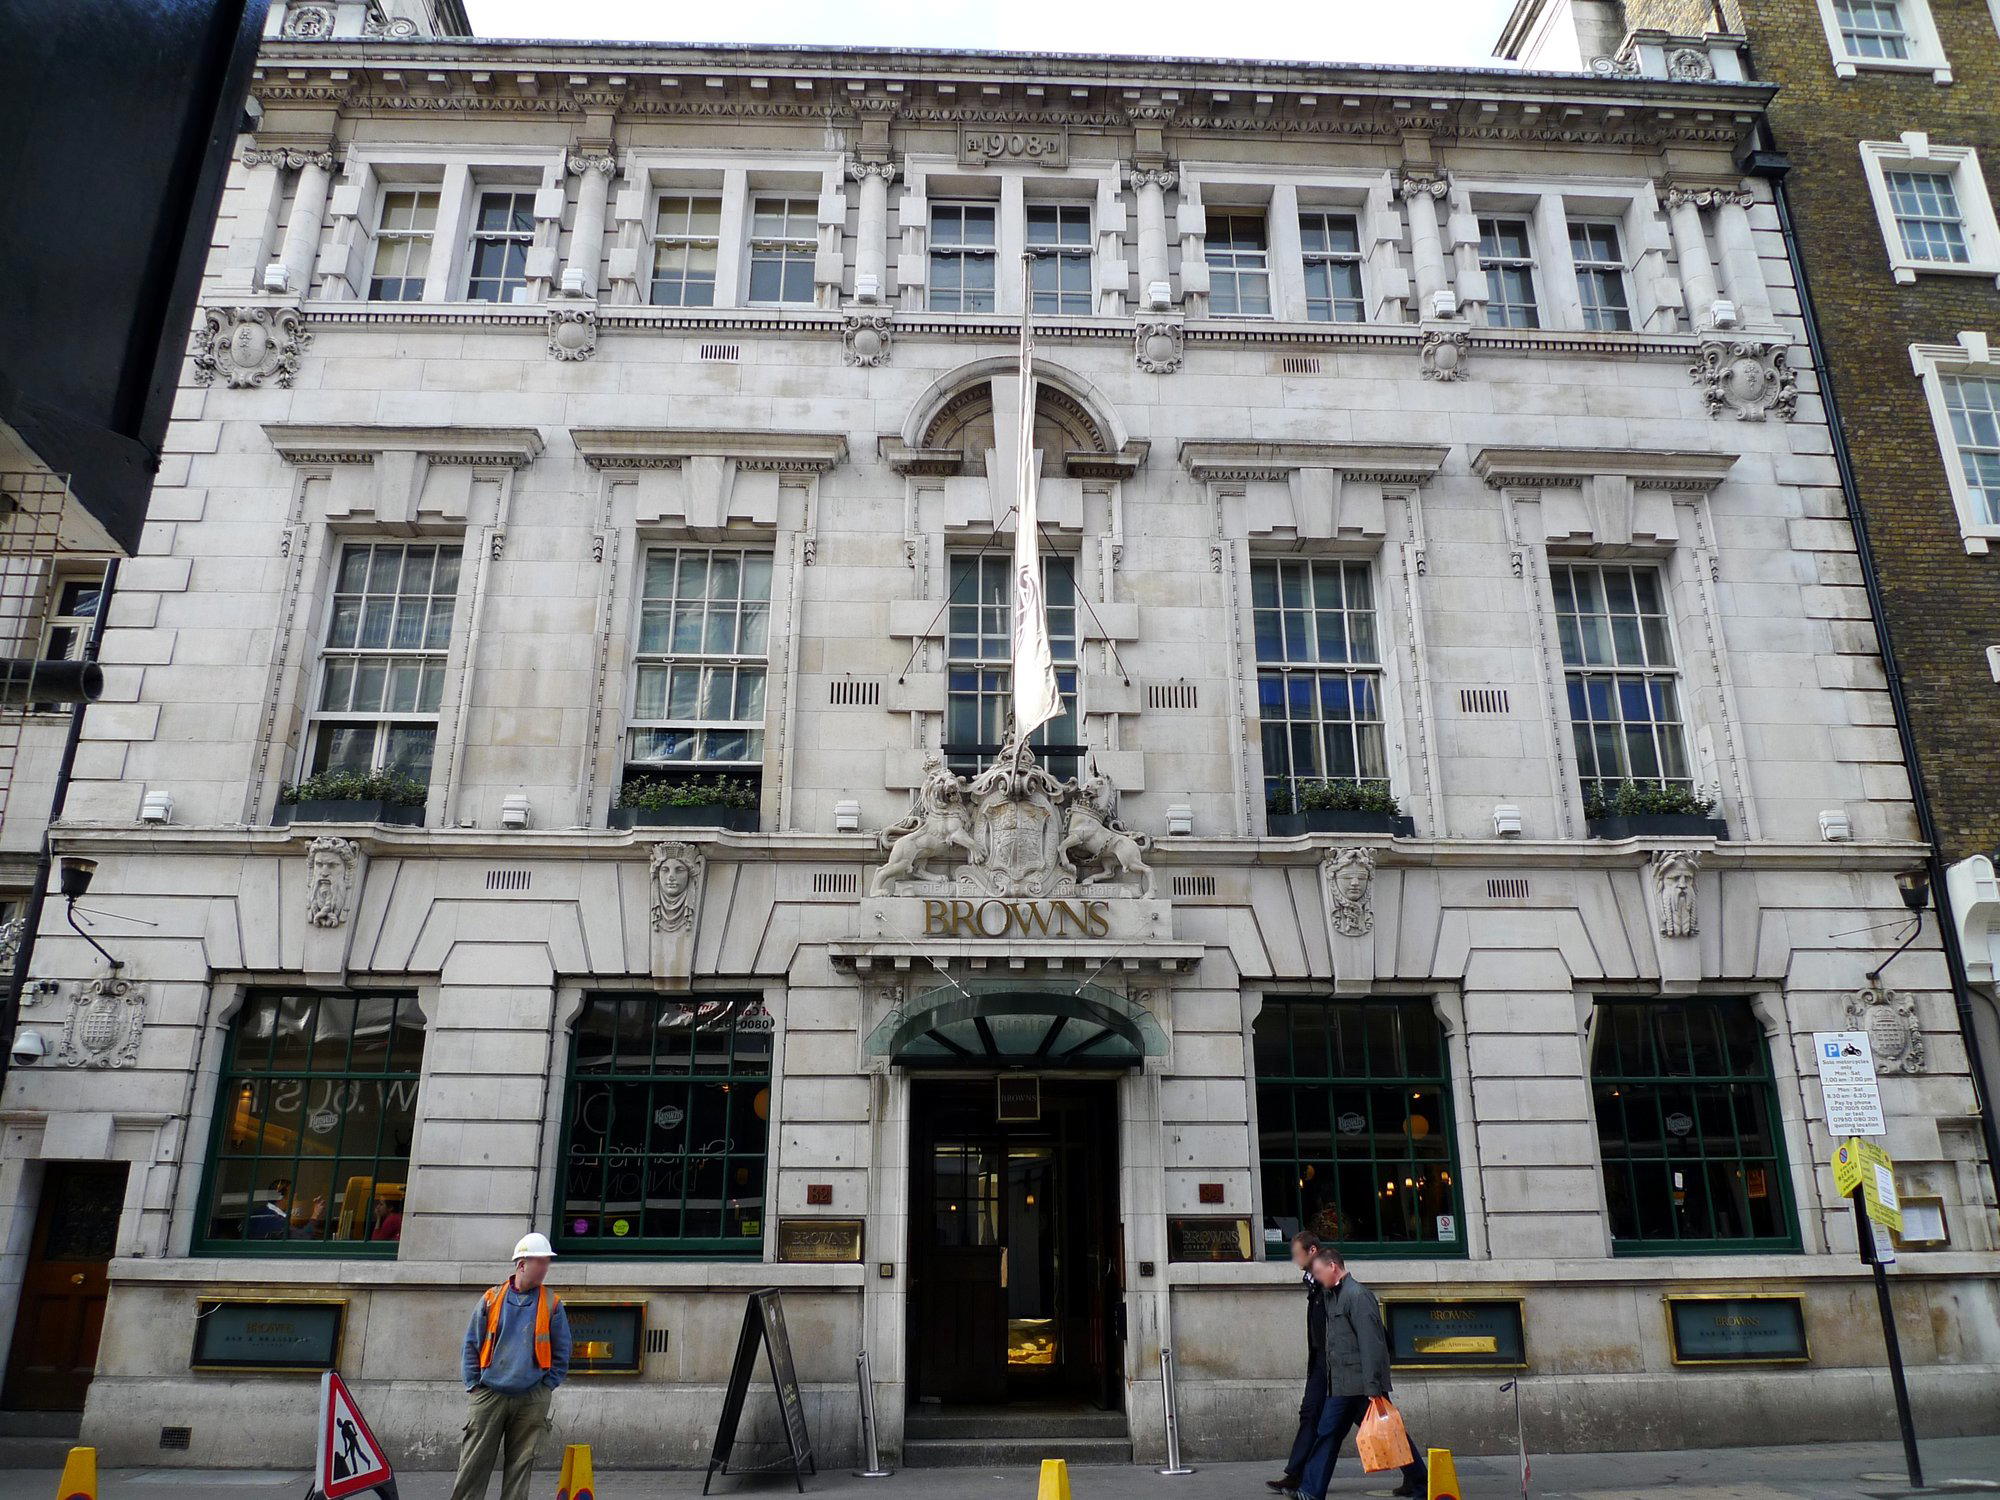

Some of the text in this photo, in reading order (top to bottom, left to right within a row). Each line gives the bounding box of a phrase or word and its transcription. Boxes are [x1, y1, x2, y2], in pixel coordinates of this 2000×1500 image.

[982, 134, 1043, 157] 1908
[1079, 884, 1117, 896] DROIT
[922, 899, 1110, 938] BROWNS
[1829, 1045, 1838, 1057] P
[1182, 1230, 1239, 1243] BROWNS
[1430, 1310, 1477, 1321] BROWNS
[1715, 1316, 1760, 1327] BROWNS
